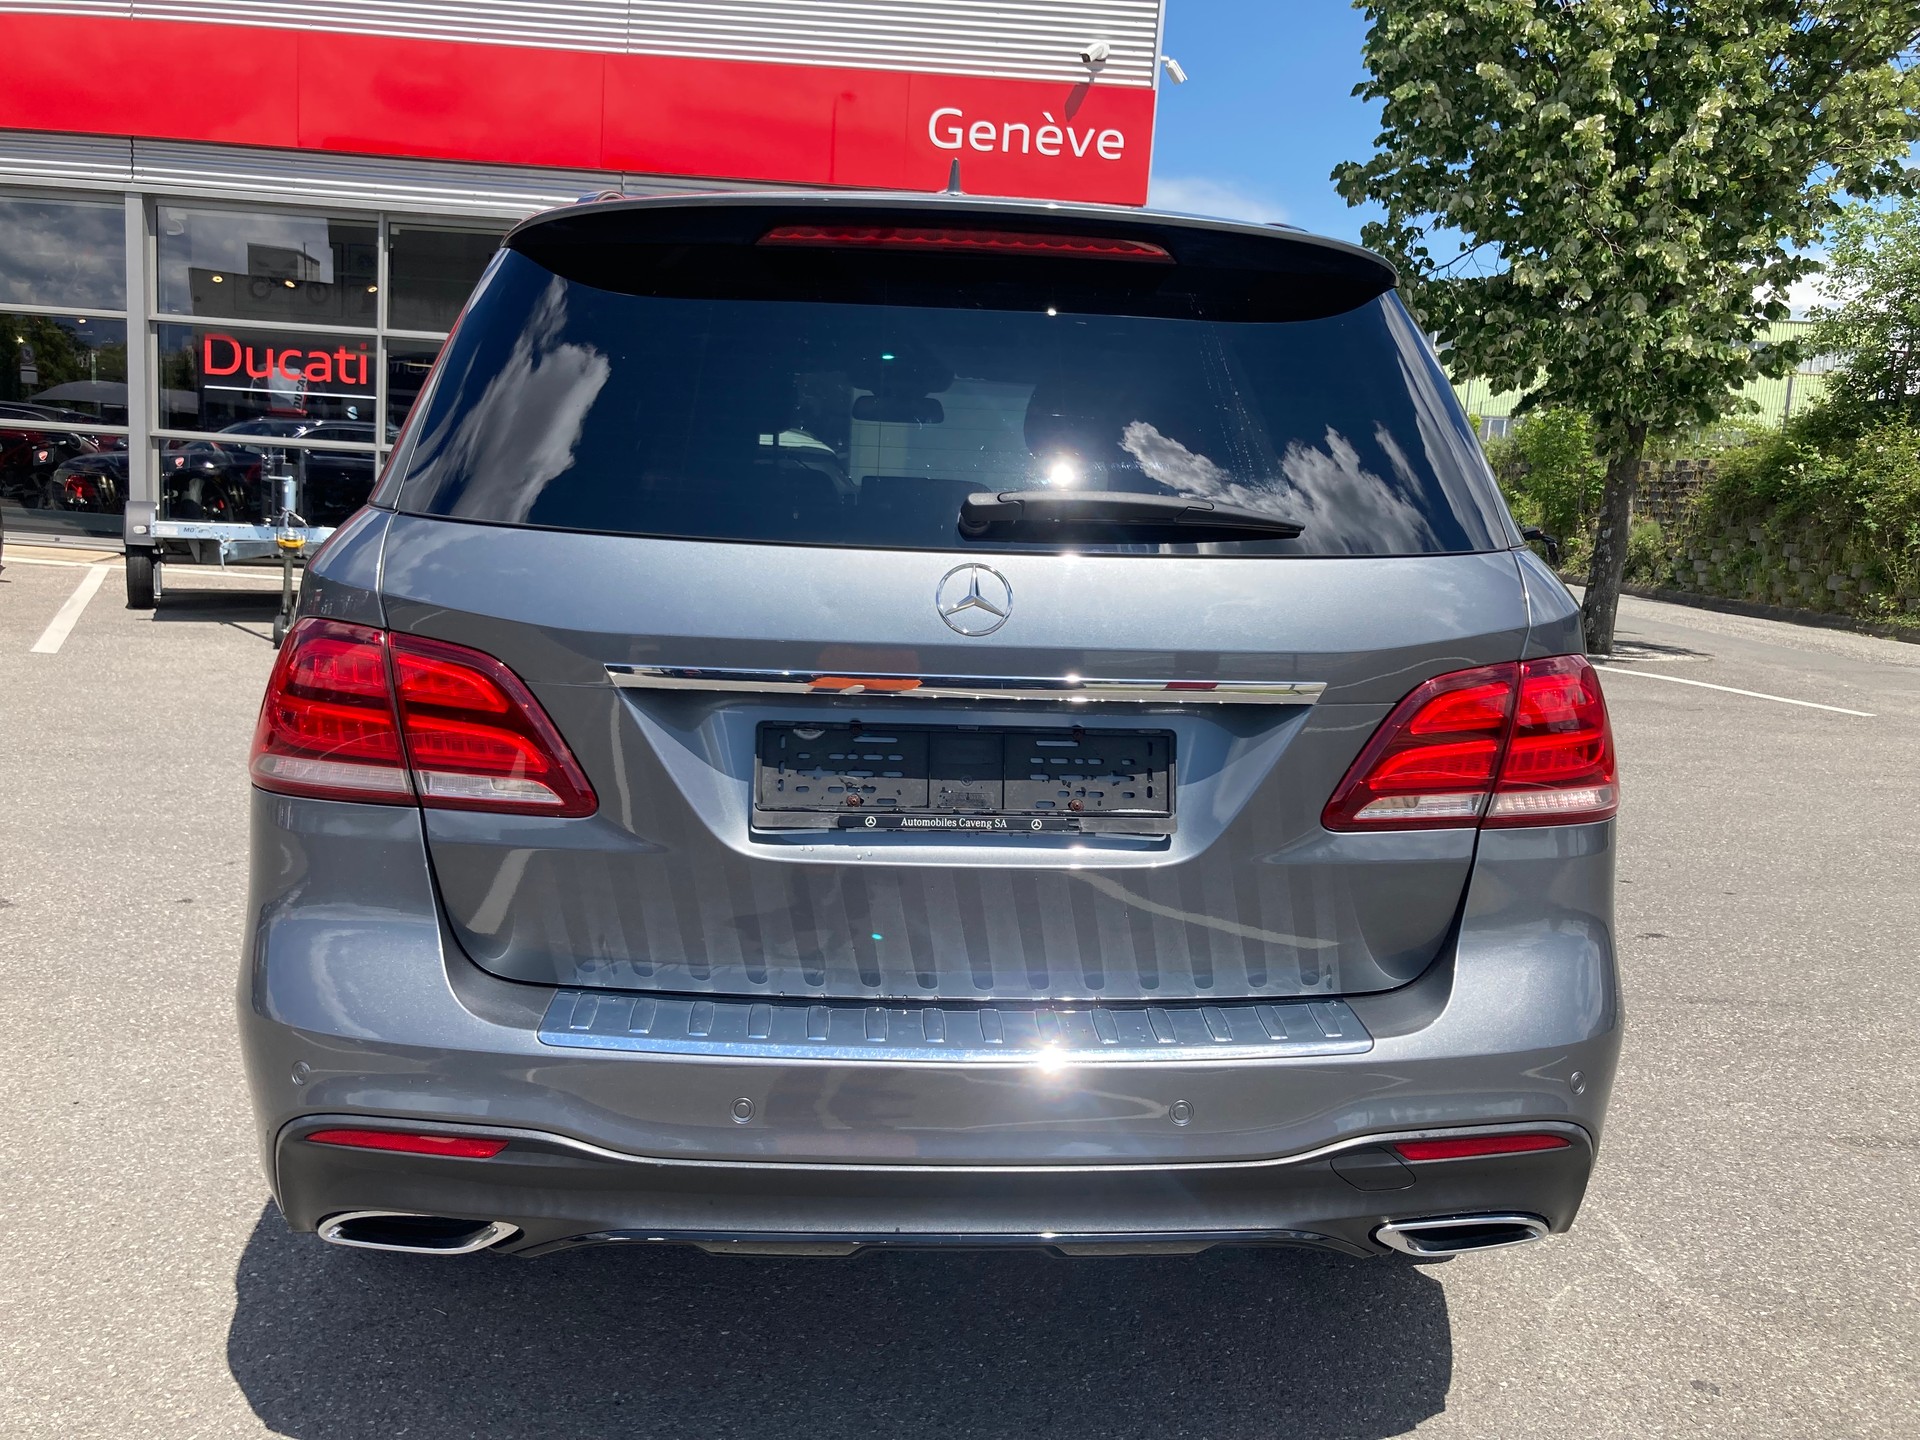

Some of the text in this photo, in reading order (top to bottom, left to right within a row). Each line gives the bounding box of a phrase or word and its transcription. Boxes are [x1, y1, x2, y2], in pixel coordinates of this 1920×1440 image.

[928, 107, 1125, 160] Genève
[204, 333, 367, 385] Ducati
[900, 817, 1007, 830] Automobiles Caveng SA
